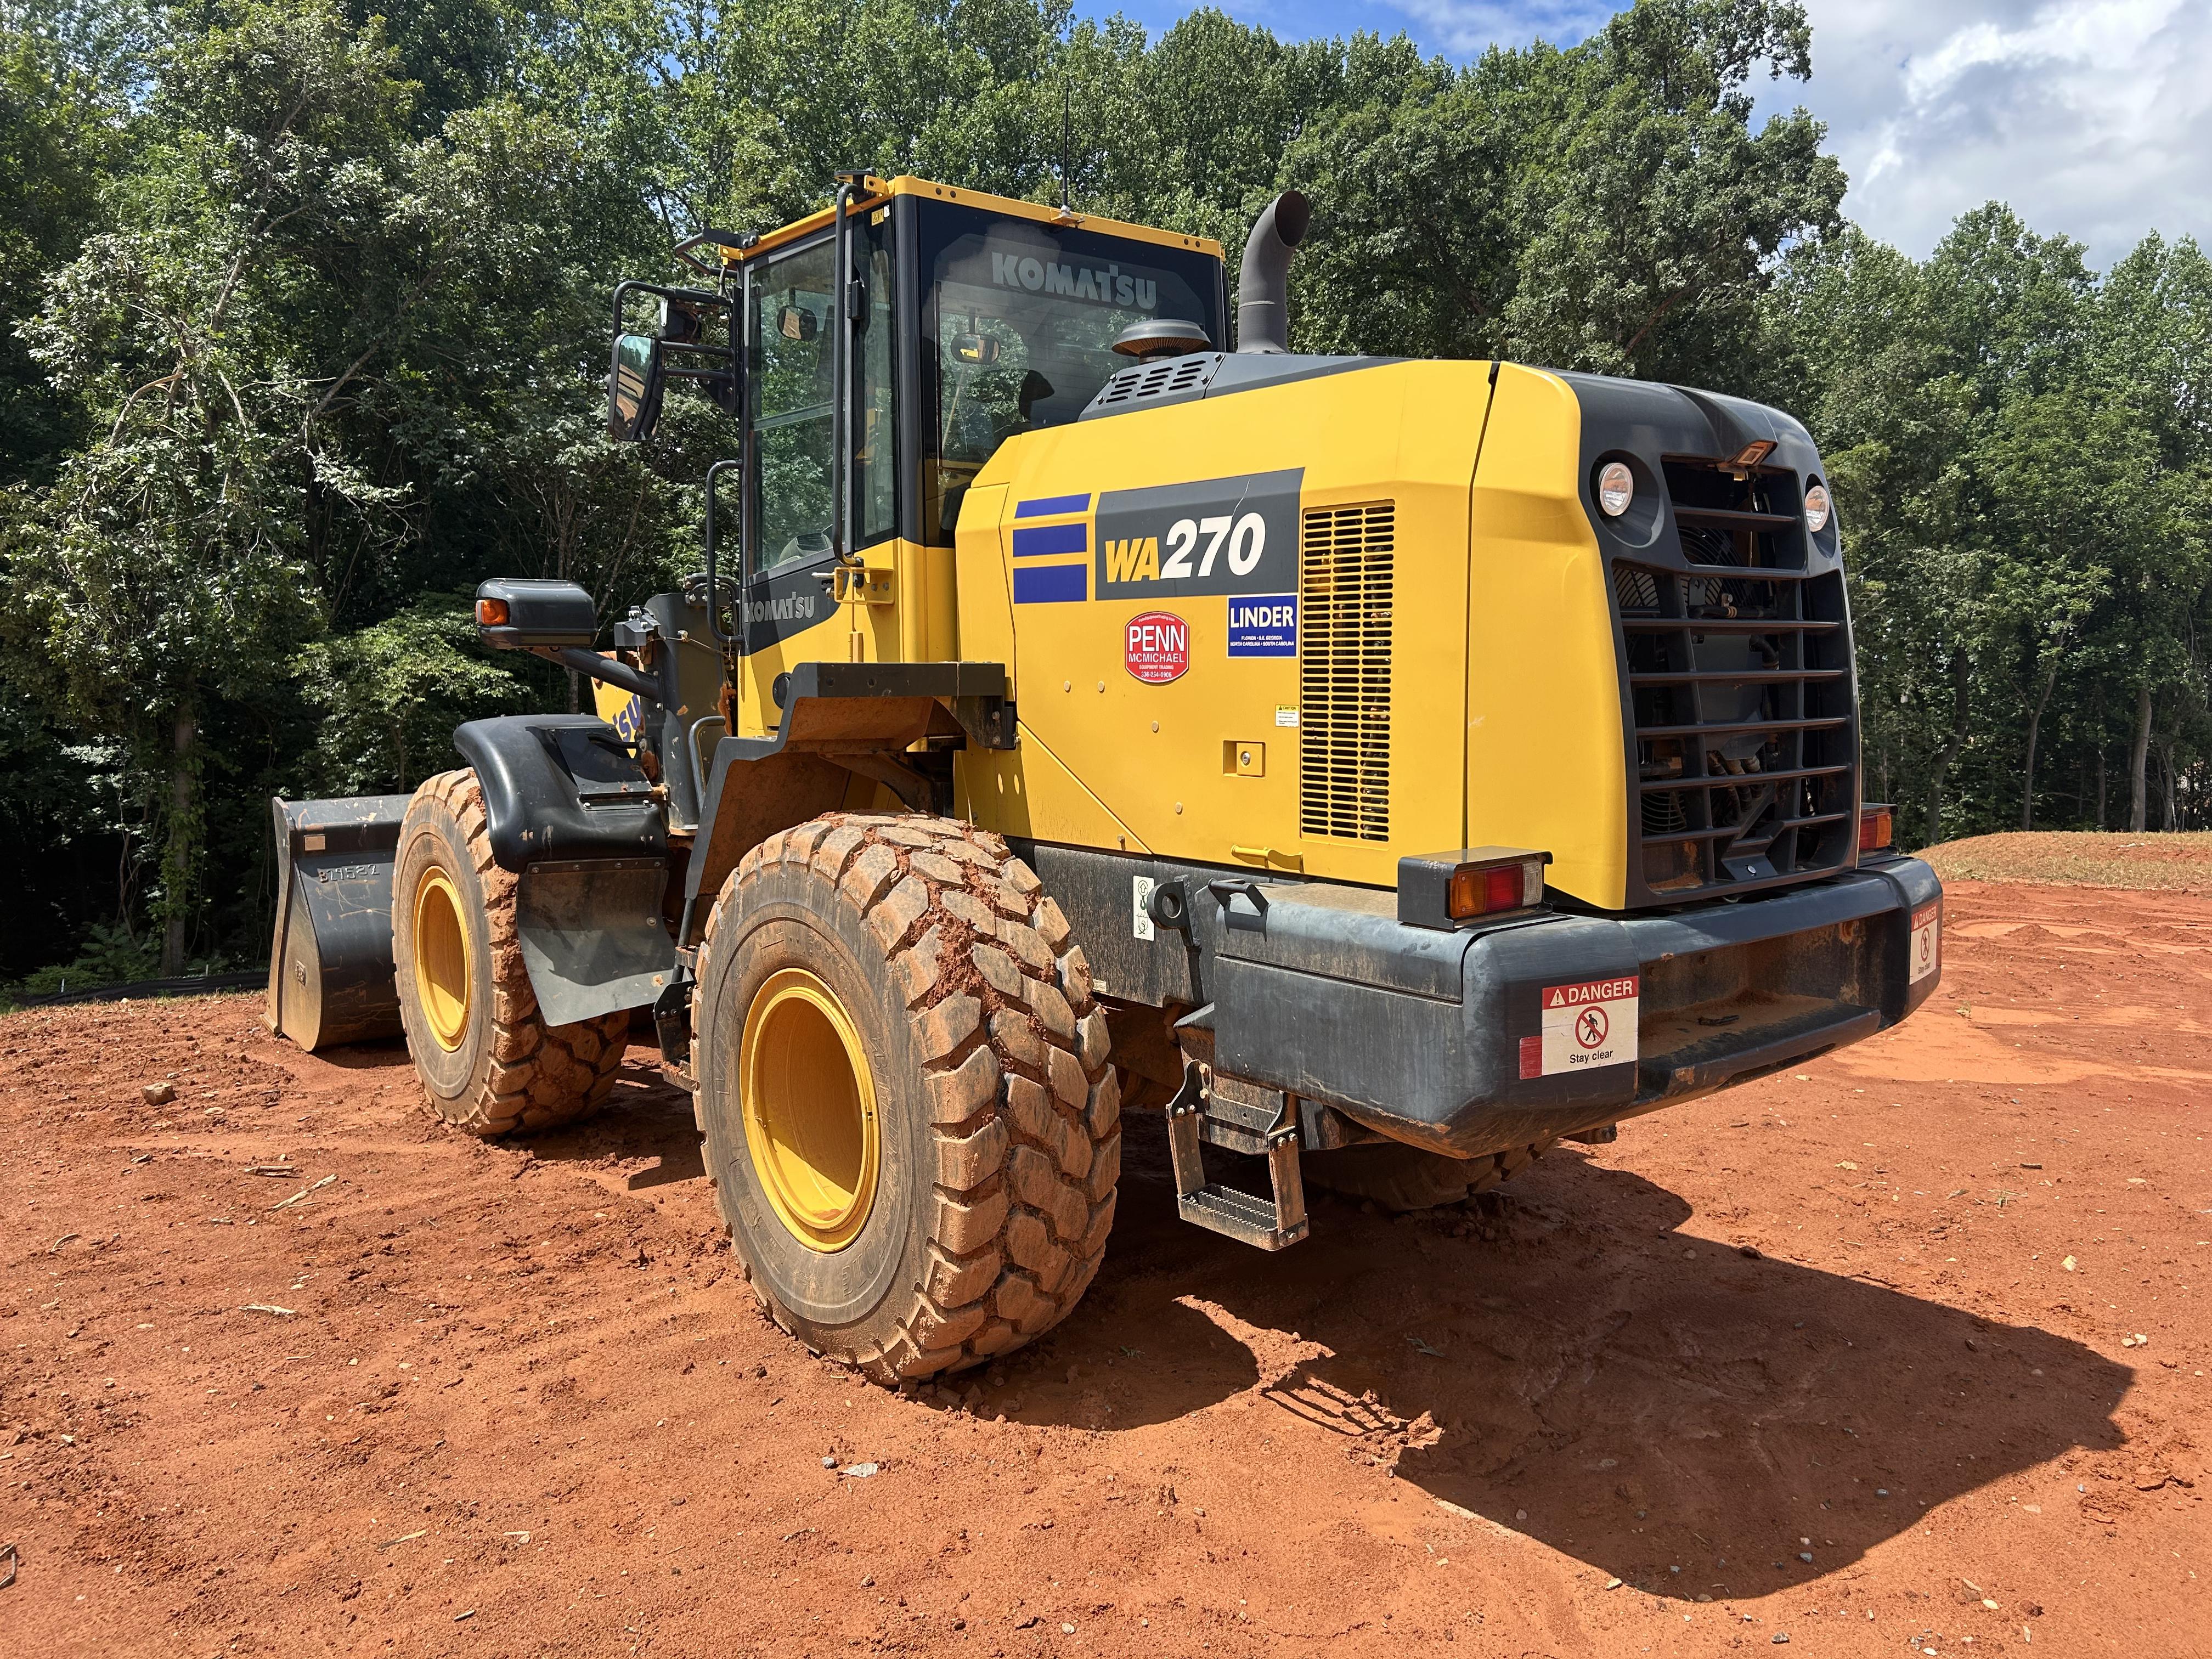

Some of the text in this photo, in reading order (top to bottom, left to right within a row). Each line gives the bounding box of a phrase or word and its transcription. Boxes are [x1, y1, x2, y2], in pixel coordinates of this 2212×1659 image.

[992, 252, 1156, 310] KOMATSU
[1105, 512, 1266, 583] WA270
[744, 591, 815, 623] KOMATSU
[1231, 606, 1294, 628] LINDER
[1129, 625, 1184, 652] PENN
[1128, 653, 1184, 663] MCMICHAEL
[1919, 906, 1937, 926] DANGER
[1568, 980, 1633, 1003] DANGER
[1570, 1050, 1613, 1064] Stay clear
